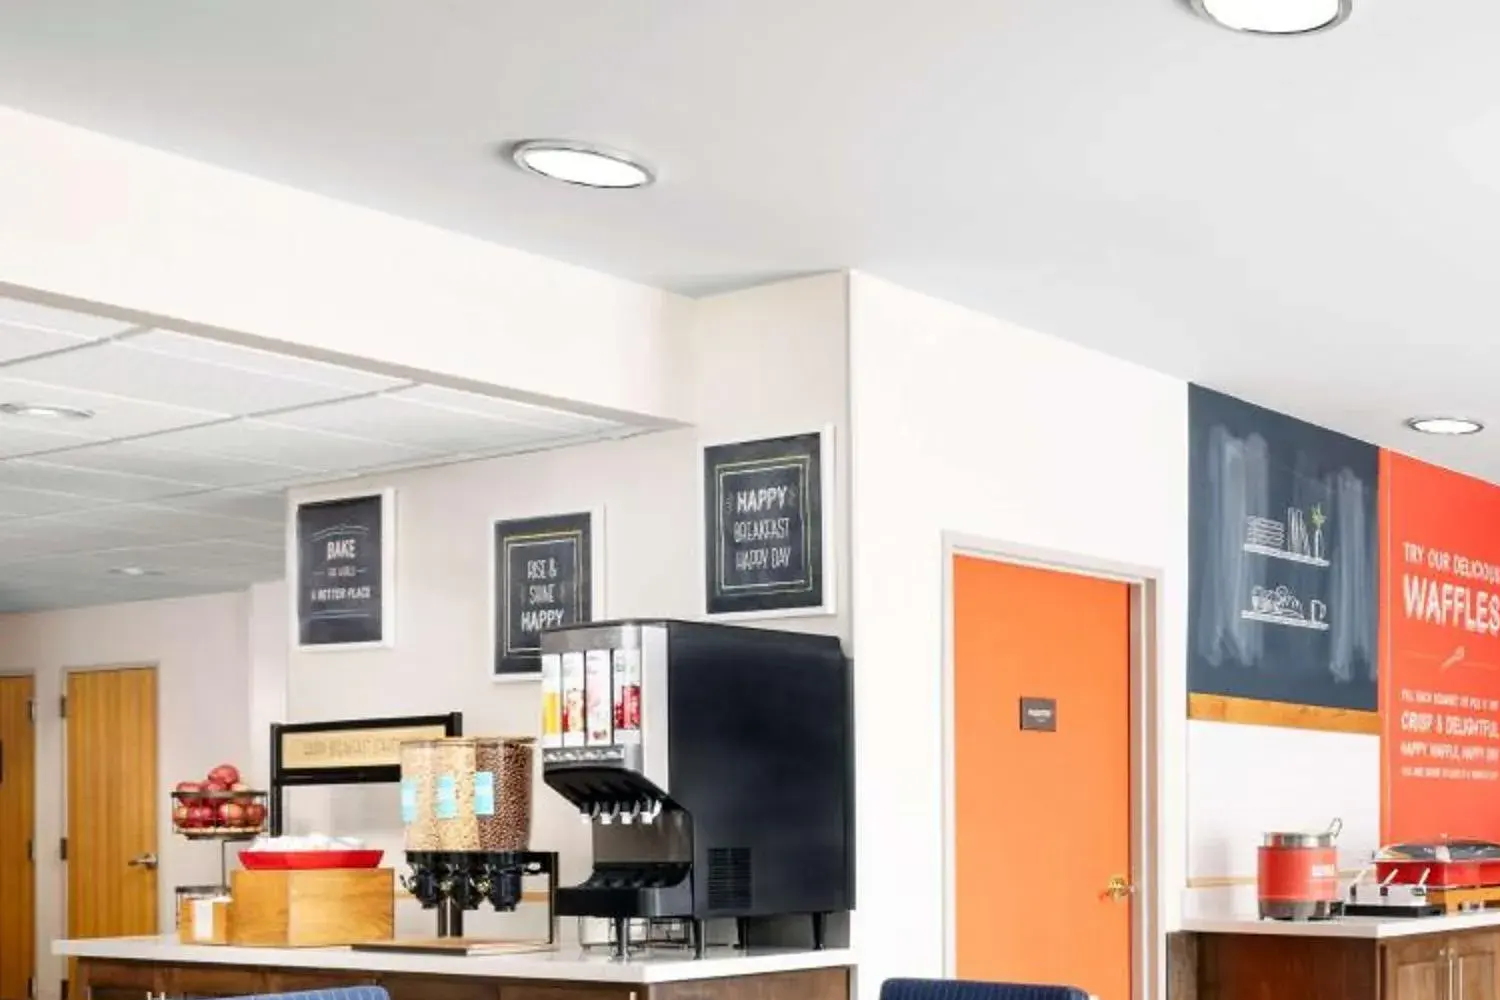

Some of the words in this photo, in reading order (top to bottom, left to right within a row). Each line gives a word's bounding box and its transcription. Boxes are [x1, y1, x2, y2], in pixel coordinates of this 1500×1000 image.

[737, 485, 788, 513] HAPPY
[734, 517, 790, 542] BREAKFAST
[327, 539, 356, 561] BAKE
[735, 548, 769, 571] HAPPY
[771, 547, 791, 569] DAY
[1403, 541, 1424, 565] TRY
[1427, 547, 1451, 573] OUR
[527, 560, 546, 579] RISE
[521, 608, 564, 632] HAPPY
